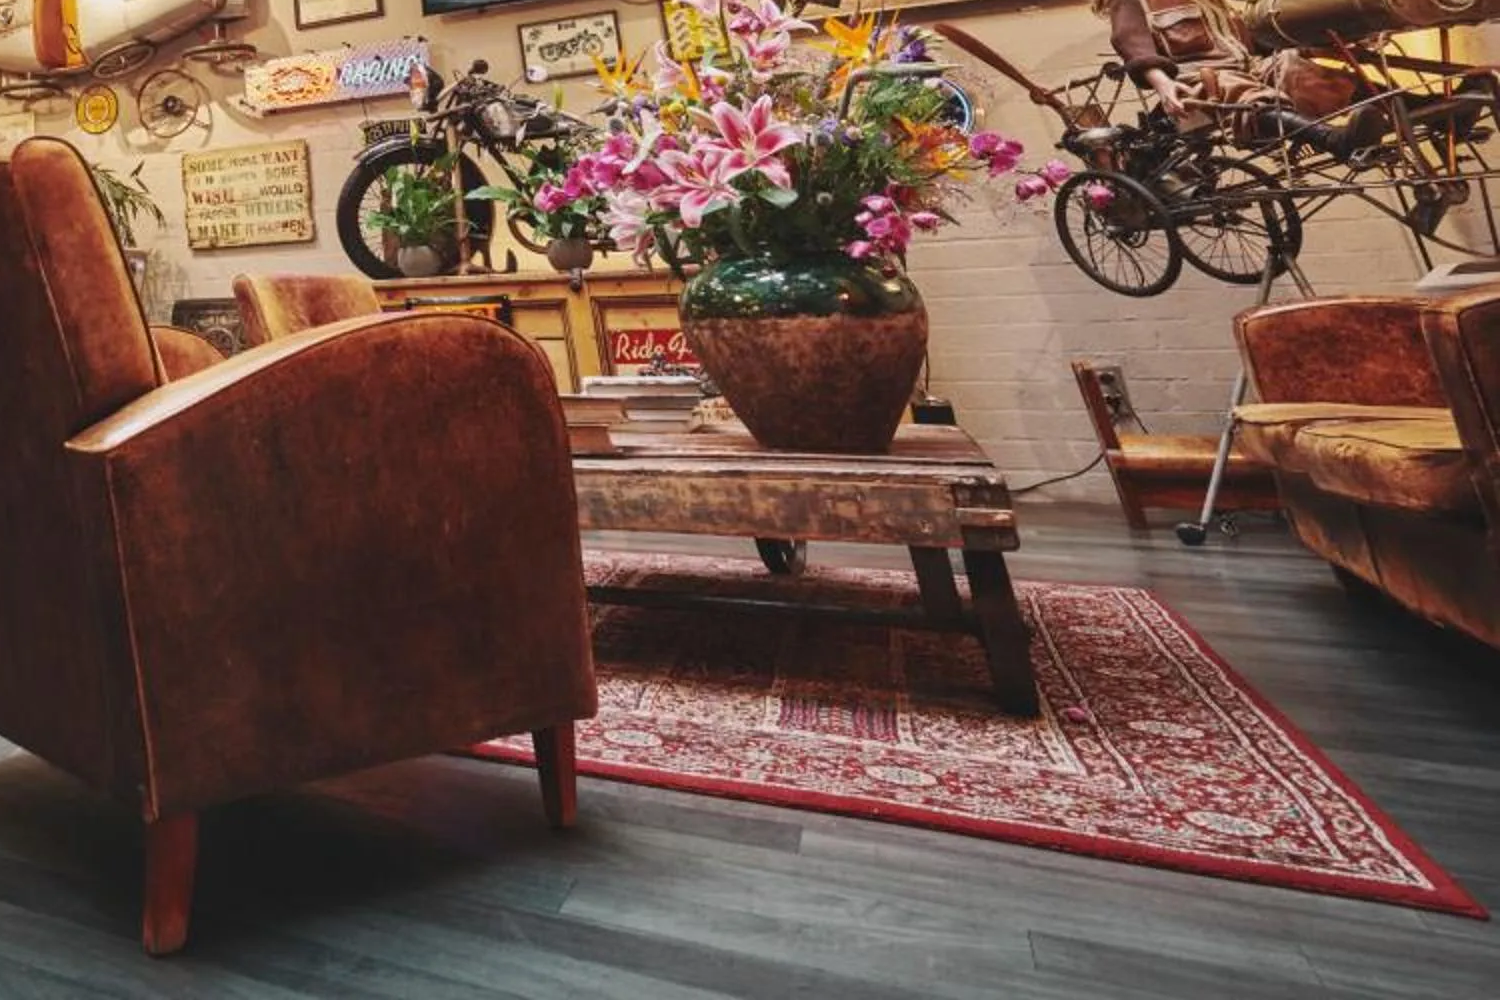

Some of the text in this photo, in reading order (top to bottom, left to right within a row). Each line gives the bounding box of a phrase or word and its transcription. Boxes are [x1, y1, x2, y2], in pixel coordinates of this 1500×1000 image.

[260, 150, 299, 165] WANT
[260, 182, 304, 197] WOULD
[197, 223, 239, 238] MAKE
[615, 331, 666, 361] Ride
